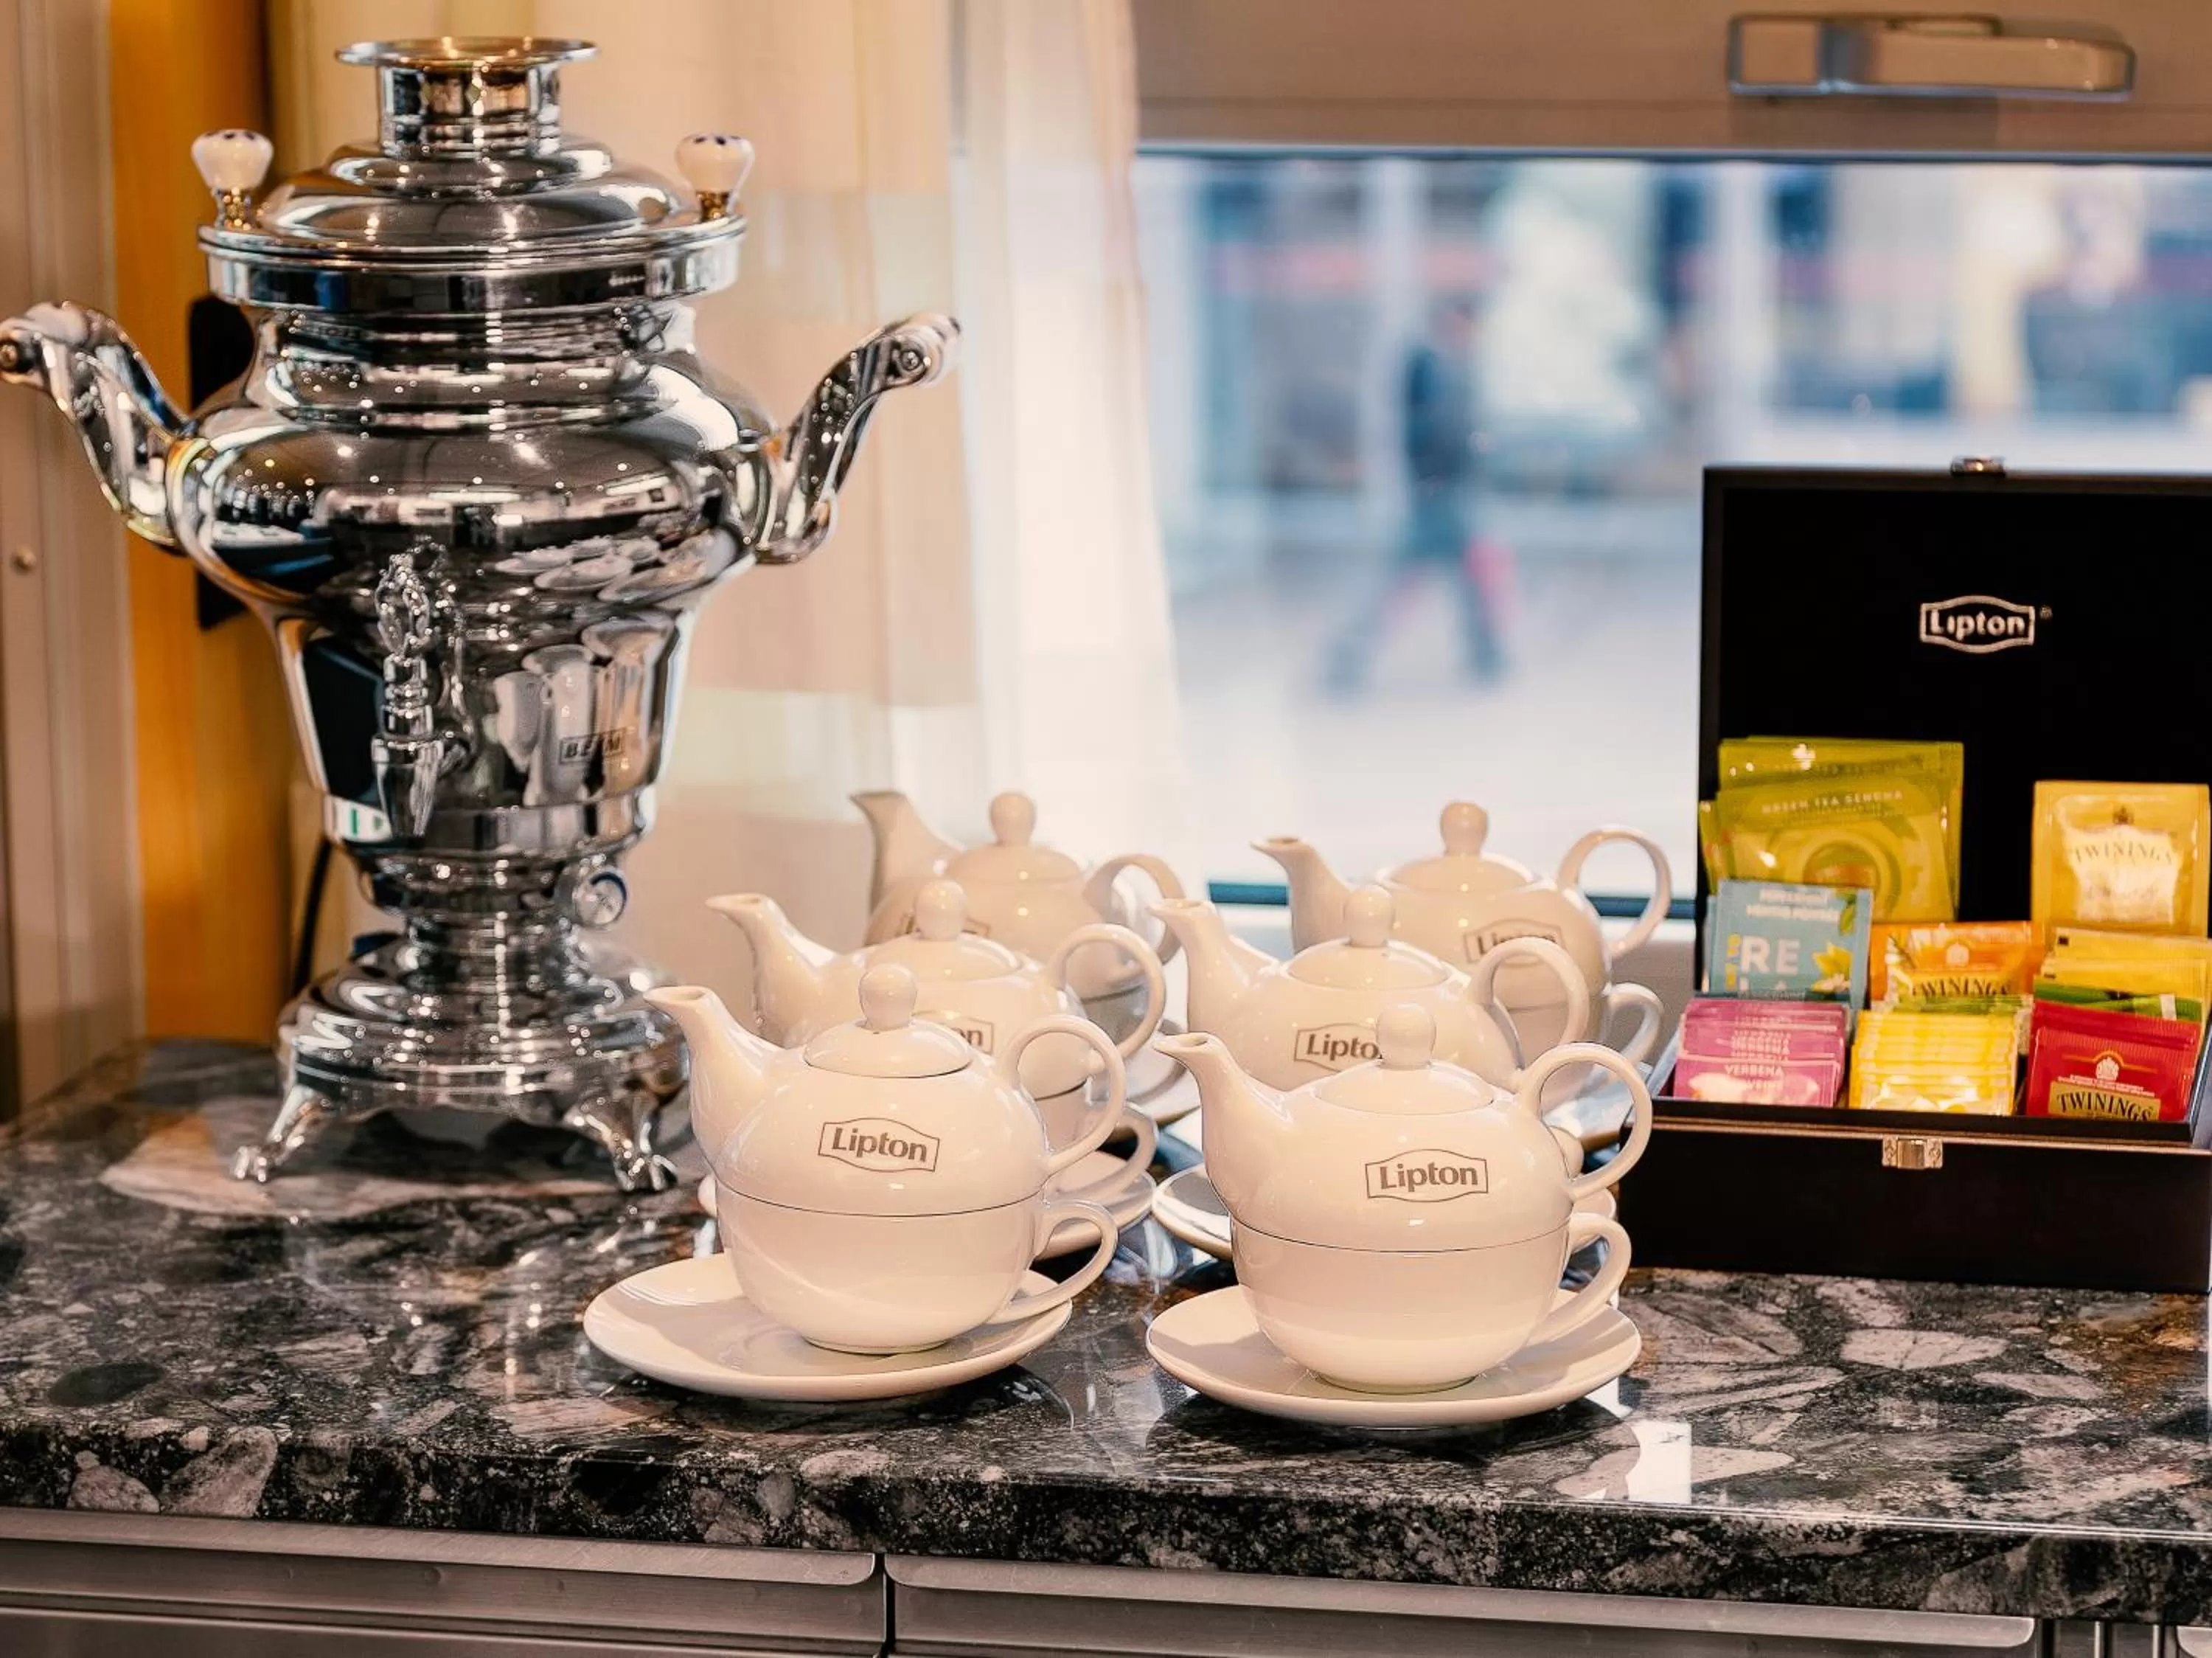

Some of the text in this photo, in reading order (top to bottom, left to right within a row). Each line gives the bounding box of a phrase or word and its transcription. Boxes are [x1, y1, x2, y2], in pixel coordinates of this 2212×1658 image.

[1930, 608, 2025, 641] Lipton
[1741, 934, 1800, 975] RE
[1307, 1033, 1380, 1061] Lipto
[2057, 1092, 2154, 1120] TWININGS
[832, 1127, 927, 1162] Lipton
[1380, 1162, 1478, 1193] Lipton
